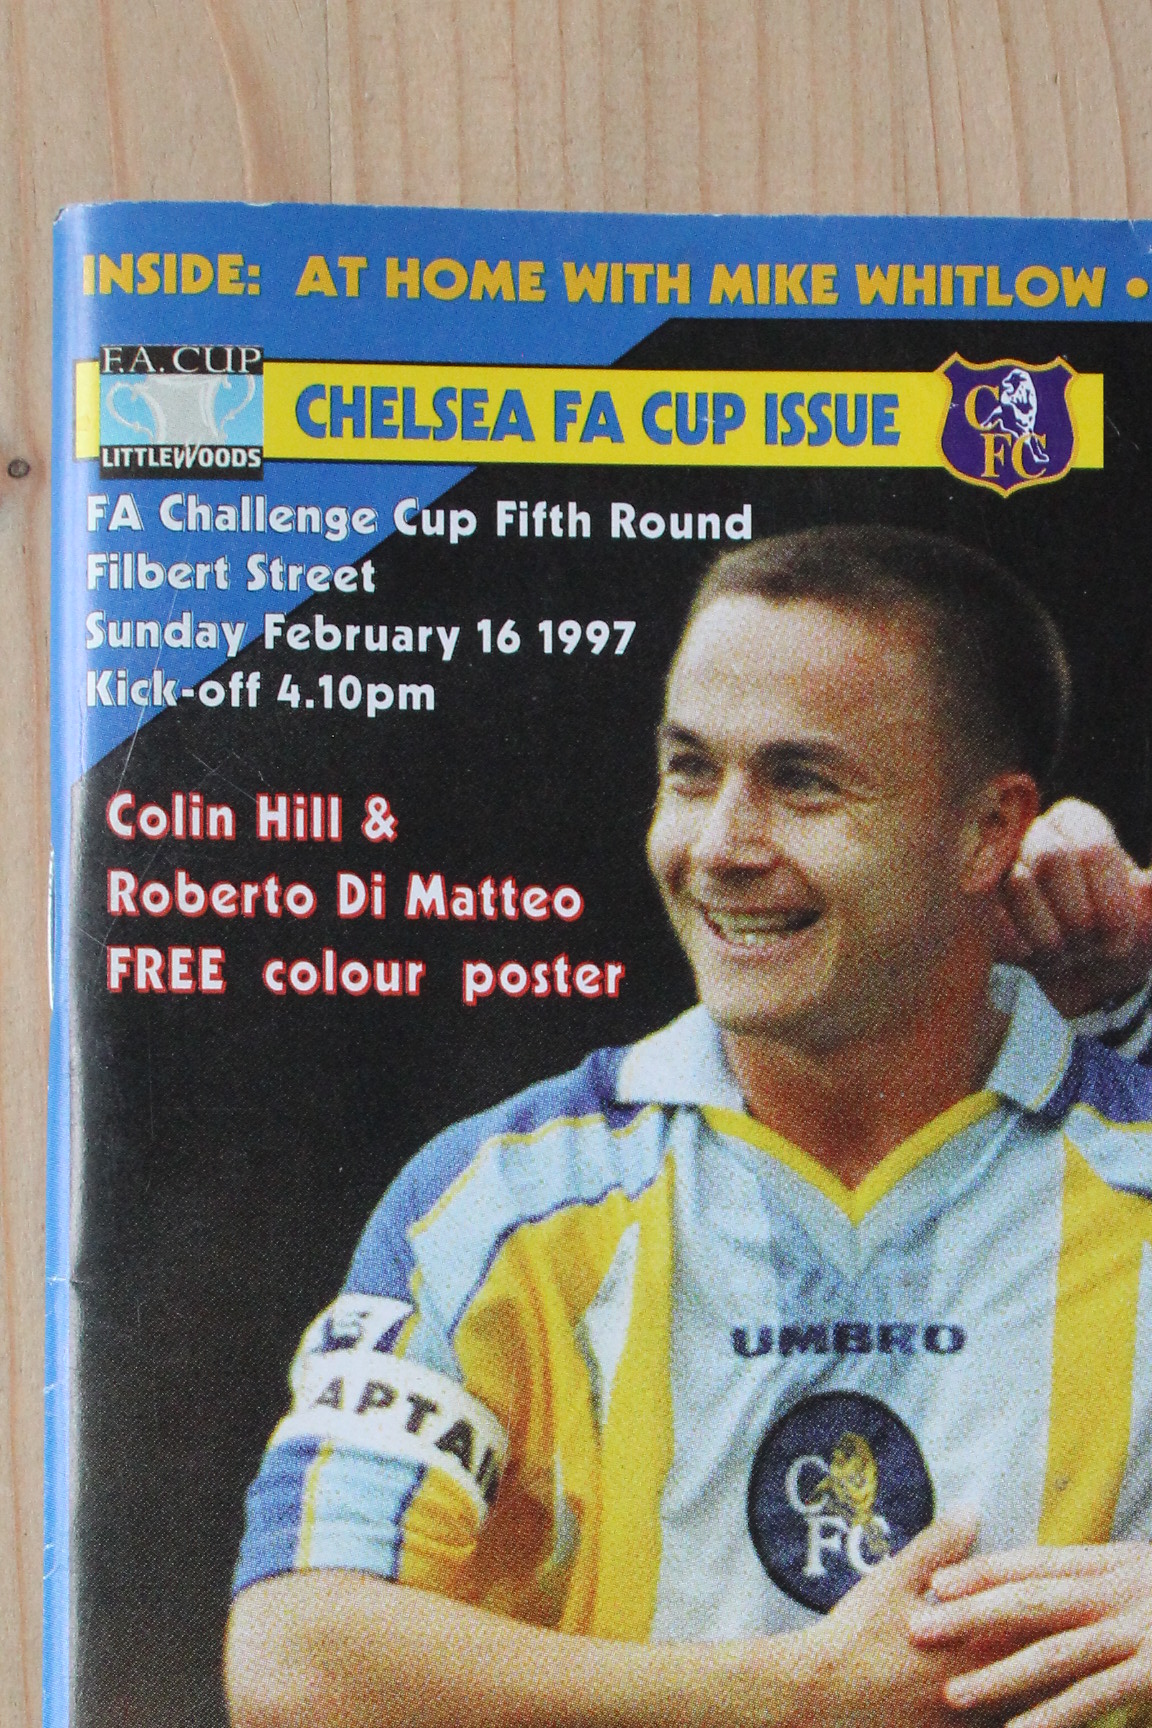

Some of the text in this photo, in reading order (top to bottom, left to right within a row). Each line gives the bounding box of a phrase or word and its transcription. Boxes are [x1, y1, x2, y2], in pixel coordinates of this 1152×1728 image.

[83, 253, 260, 295] INSIDE:
[295, 255, 367, 297] AT
[385, 257, 546, 303] HOME
[563, 262, 691, 304] WITH
[709, 263, 839, 305] MIKE
[855, 264, 1106, 308] WHITLOW
[173, 348, 262, 374] CUP
[295, 383, 900, 447] CHELSEA FA CUP ISSUE
[102, 445, 262, 470] LITTLEWOODS
[87, 495, 752, 544] FA Challenge Cup Fifth Round
[87, 554, 376, 594] Filbert Street
[86, 612, 637, 660] Sunday February 16 1997
[87, 671, 436, 717] Kick-off 4.10pm
[105, 792, 399, 842] Colin Hill &
[105, 869, 585, 921] Roberto Di Matteo
[105, 946, 626, 1006] FREE colour poster
[731, 1321, 967, 1358] UMBRO
